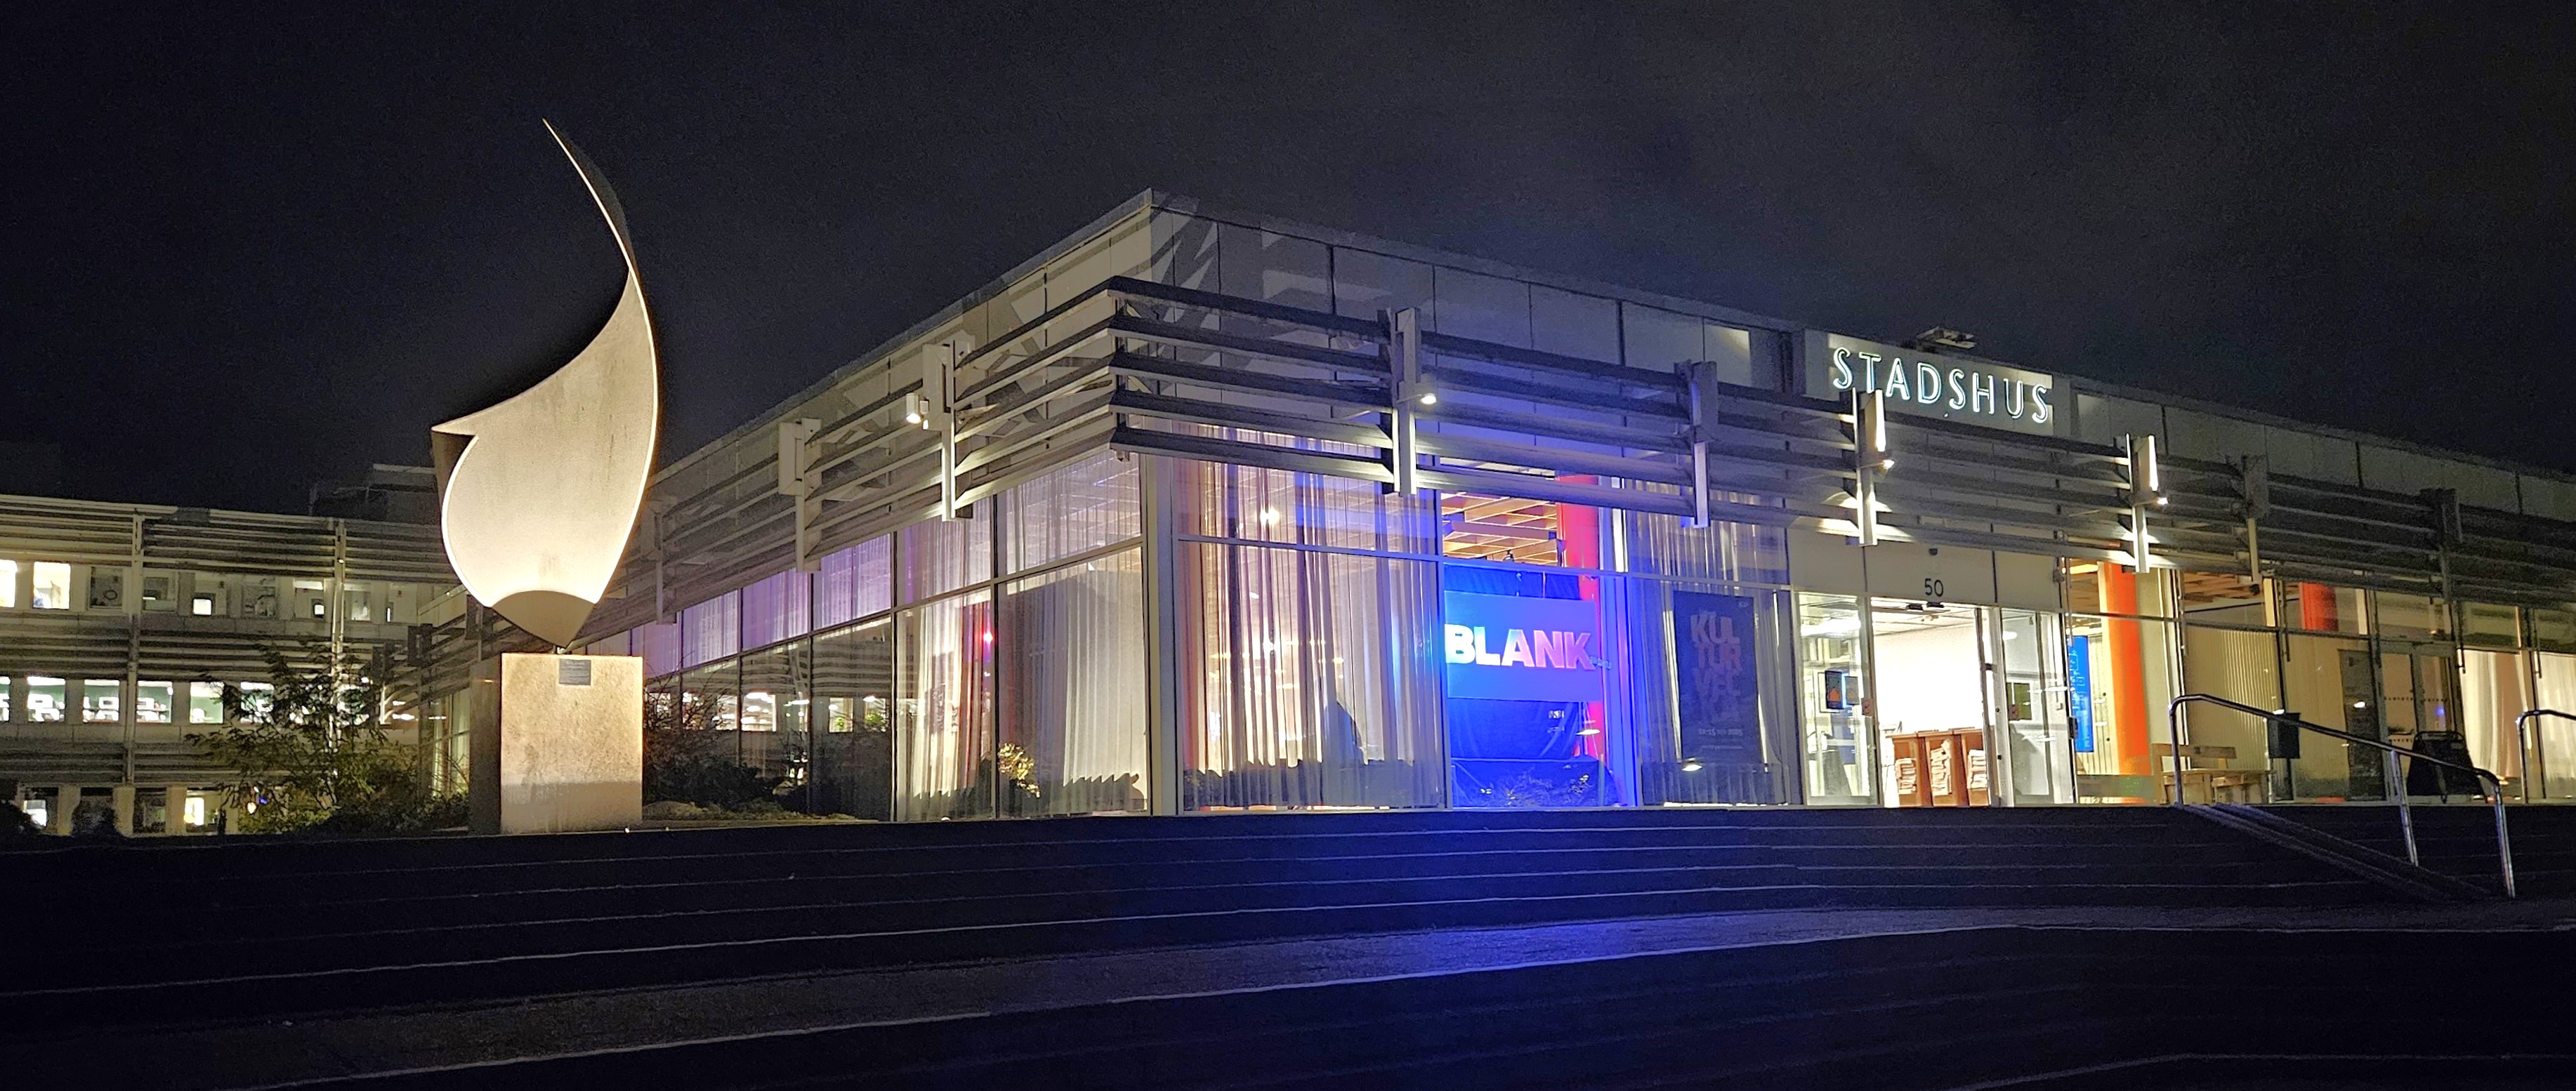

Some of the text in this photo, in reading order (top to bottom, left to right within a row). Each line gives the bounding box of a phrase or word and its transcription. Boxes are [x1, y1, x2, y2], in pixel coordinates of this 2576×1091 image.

[1832, 347, 2048, 423] STADSHUS
[1924, 578, 1944, 597] 50
[1444, 623, 1596, 670] BLANK
[1690, 613, 1740, 644] KUL
